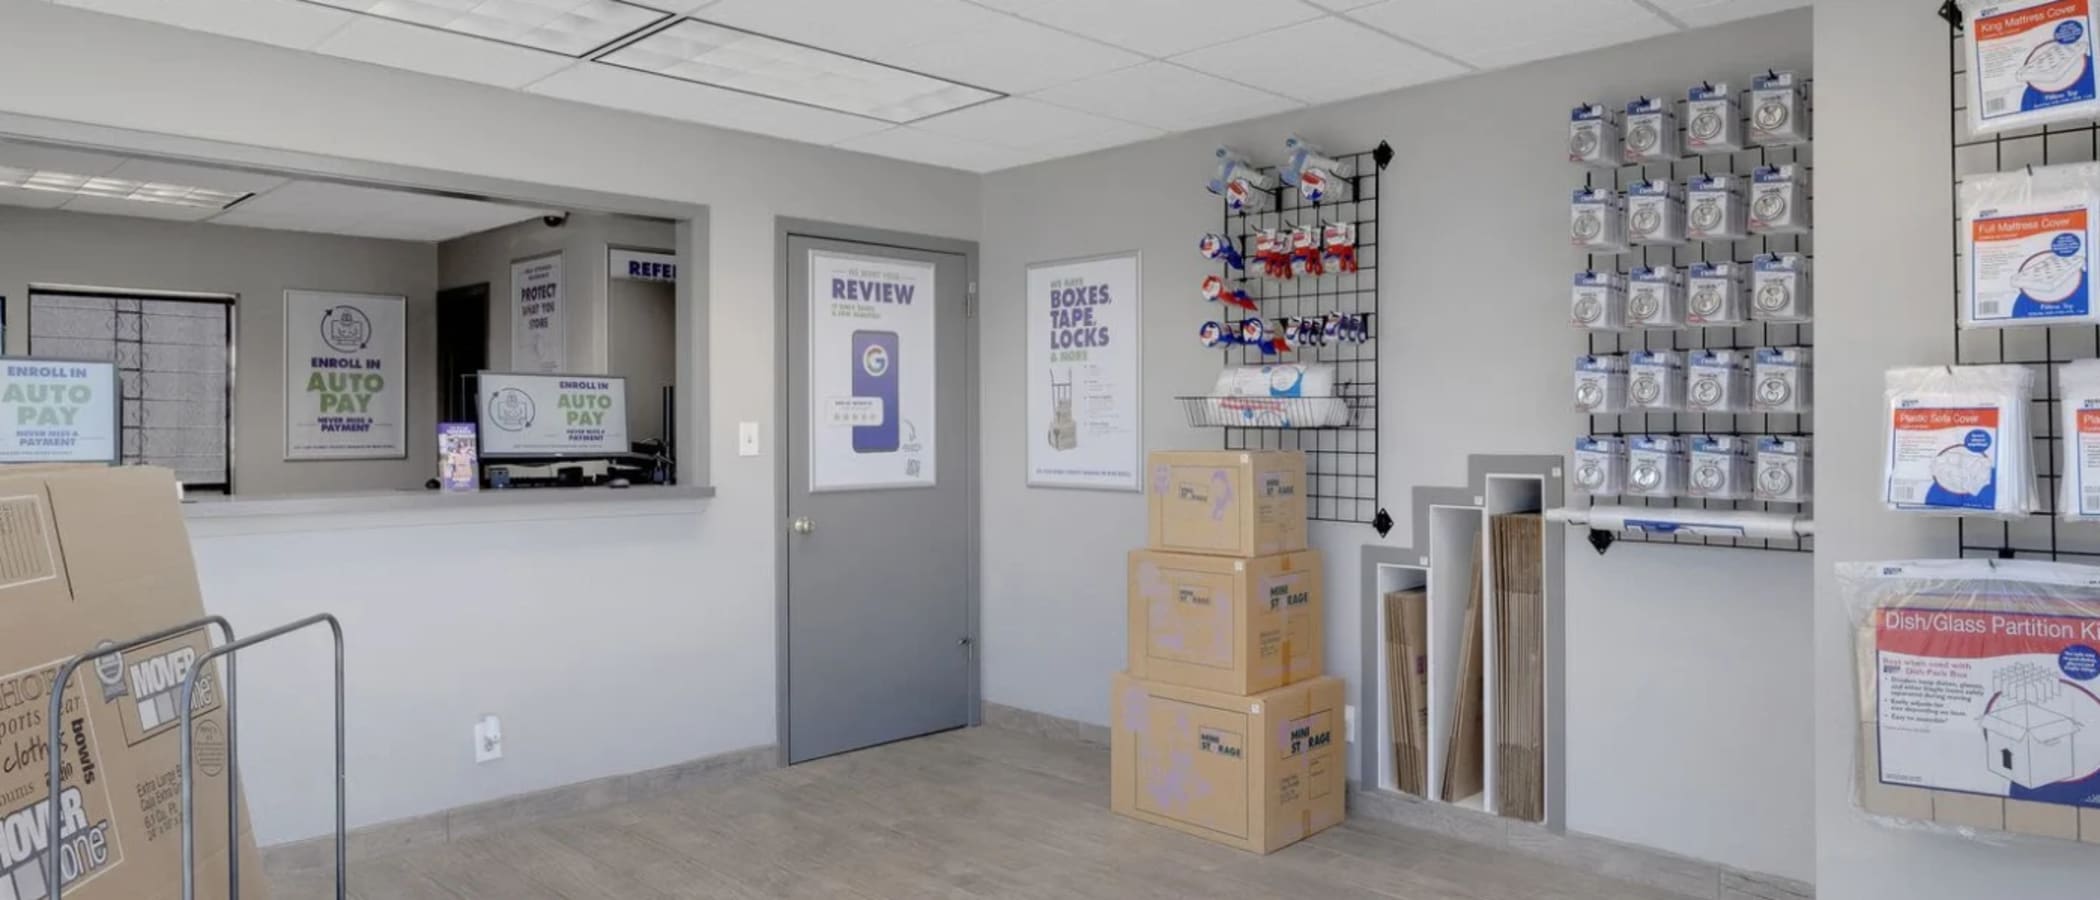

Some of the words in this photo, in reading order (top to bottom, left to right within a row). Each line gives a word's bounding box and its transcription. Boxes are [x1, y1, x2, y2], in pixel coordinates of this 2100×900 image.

[1982, 21, 2003, 33] King
[2004, 12, 2046, 28] Mattress
[2046, 5, 2076, 18] Cover
[1979, 221, 1997, 234] Full
[1998, 219, 2039, 233] Mattress
[2041, 217, 2071, 229] Cover
[521, 283, 557, 303] PROTECT
[832, 278, 915, 305] REVIEW
[1050, 283, 1112, 309] BOXES,
[1050, 307, 1097, 329] TAPE,
[1050, 326, 1110, 350] LOCKS
[7, 366, 67, 378] ENROLL
[70, 367, 87, 378] IN
[311, 358, 363, 369] ENROLL
[366, 359, 381, 369] IN
[306, 371, 385, 393] AUTO
[559, 381, 596, 390] ENROLL
[597, 382, 609, 390] IN
[2, 383, 92, 404] AUTO
[557, 394, 612, 409] AUTO
[320, 393, 372, 413] PAY
[17, 406, 80, 426] PAY
[566, 411, 605, 426] PAY
[1900, 413, 1928, 424] Plastic
[1929, 413, 1952, 423] Sofa
[1952, 413, 1980, 424] Cover
[321, 424, 371, 432] PAYMENT
[19, 438, 76, 446] PAYMENT
[1270, 584, 1288, 597] MINI
[1885, 610, 1987, 634] Dish/Glass
[1992, 614, 2074, 639] Partition
[2081, 620, 2100, 641] Ki
[1201, 733, 1219, 743] MINI
[1291, 726, 1310, 741] MINI
[72, 717, 96, 785] bowls
